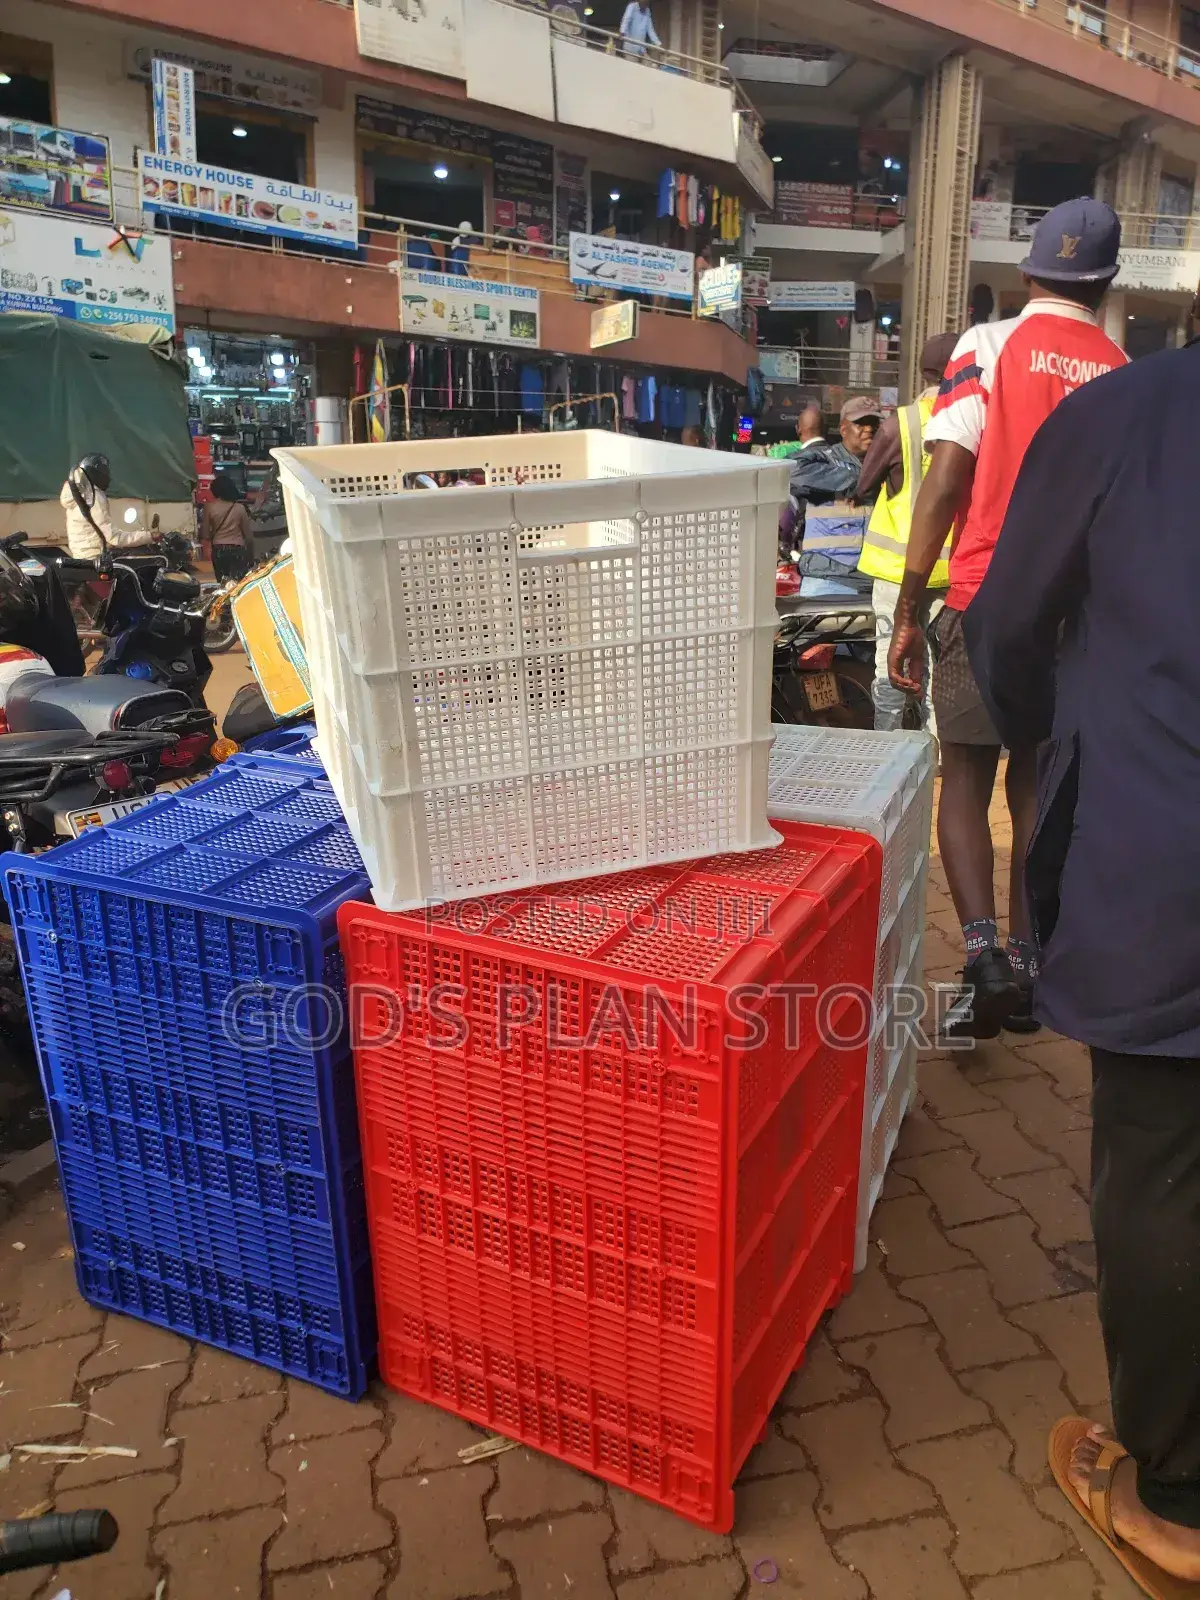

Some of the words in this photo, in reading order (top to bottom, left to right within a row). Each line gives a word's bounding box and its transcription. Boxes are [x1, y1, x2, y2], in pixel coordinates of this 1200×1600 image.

[144, 156, 202, 178] ENERGY
[206, 170, 254, 190] HOUSE
[641, 259, 675, 271] AGENCY
[418, 273, 445, 287] DOUBLE
[447, 277, 485, 292] BLESSINGS
[486, 282, 512, 296] SPORTS
[514, 286, 537, 299] CENTRE
[1029, 349, 1112, 383] JACKSONV
